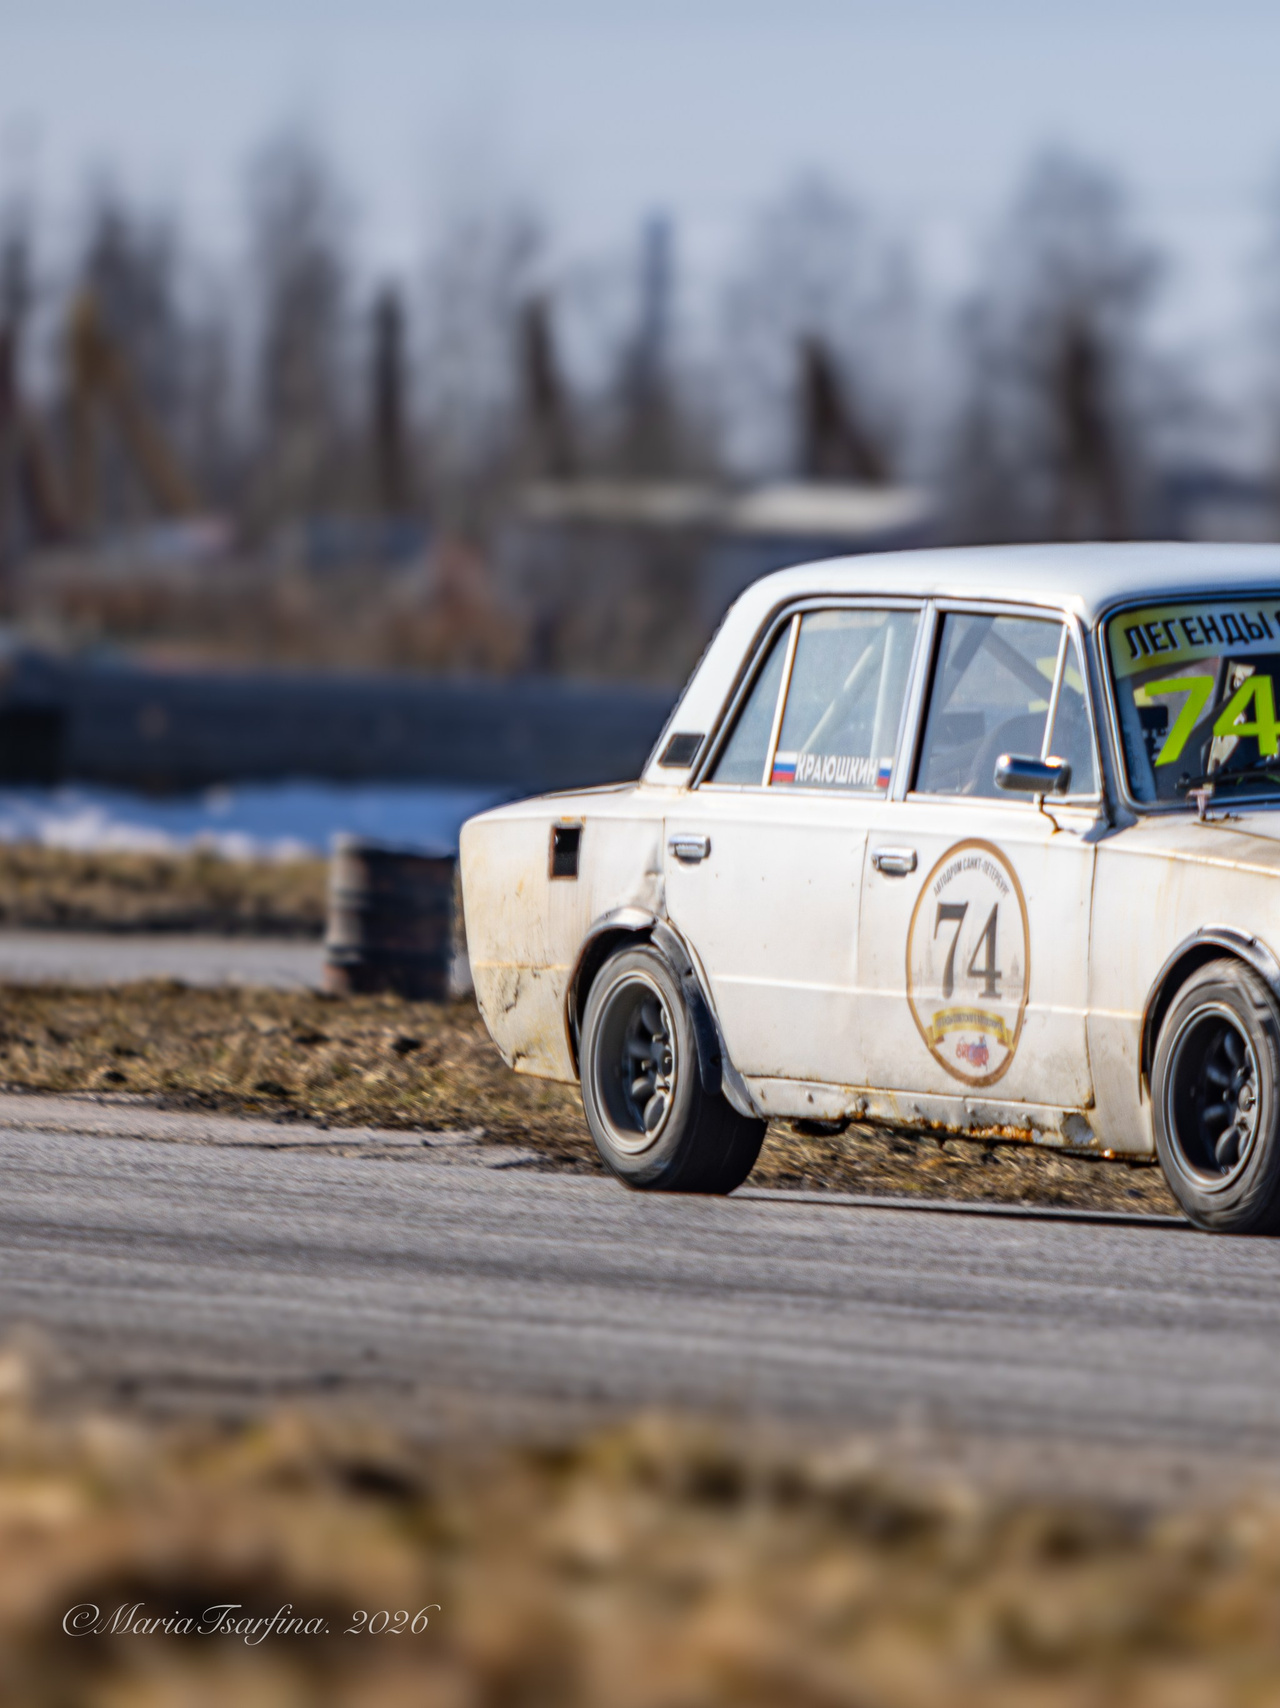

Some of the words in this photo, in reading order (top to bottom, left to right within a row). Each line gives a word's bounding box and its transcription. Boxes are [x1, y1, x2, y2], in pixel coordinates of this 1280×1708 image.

[1123, 611, 1275, 660] ЛЕГЕНДЫ
[795, 753, 879, 785] КРАЮШКИН
[933, 900, 1003, 1000] 74
